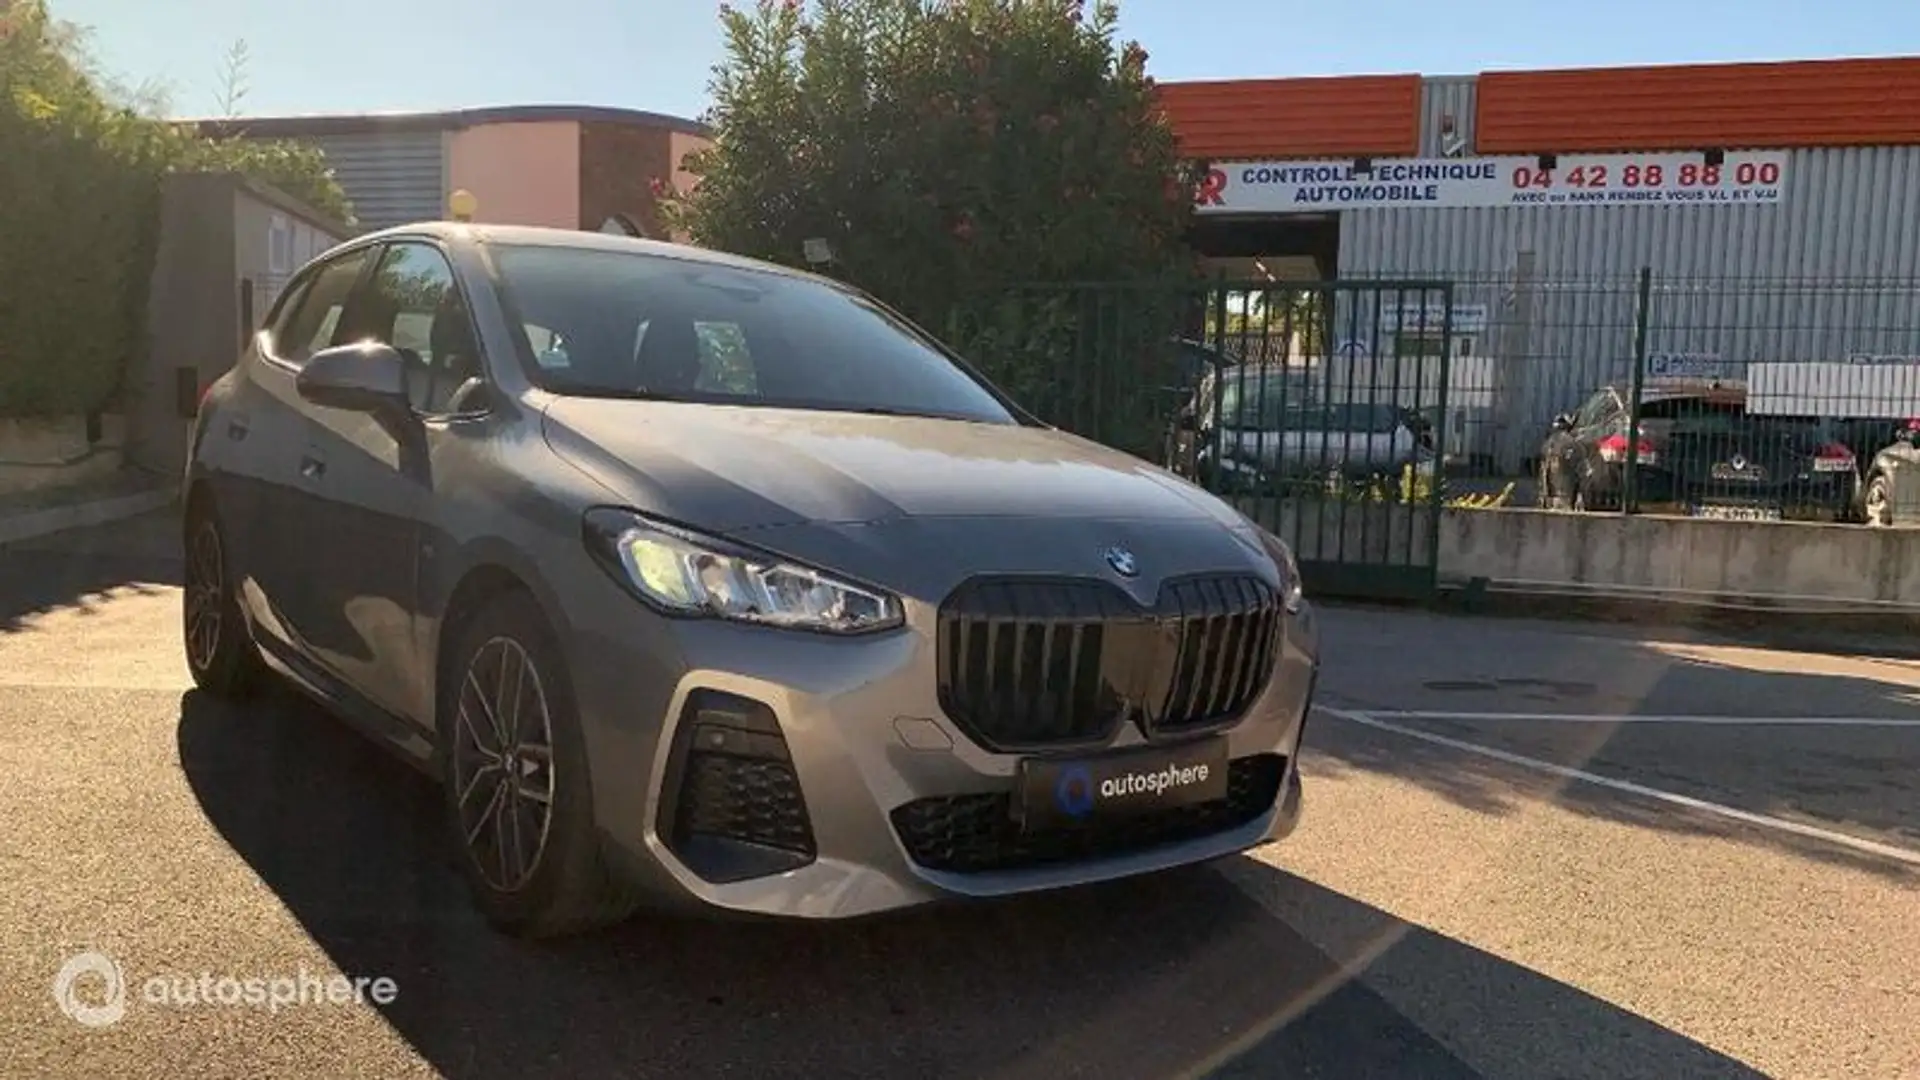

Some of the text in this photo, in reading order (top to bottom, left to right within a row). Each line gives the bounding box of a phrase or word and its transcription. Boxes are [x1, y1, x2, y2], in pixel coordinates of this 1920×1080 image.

[1242, 163, 1497, 184] CONTROLE TECHNIQUE
[1512, 162, 1780, 189] 04 42 88 88 00
[1294, 184, 1438, 203] AUTOMOBILE
[1608, 191, 1663, 201] RENDEZ
[1666, 191, 1705, 201] VOUS
[1101, 762, 1209, 798] autosphere
